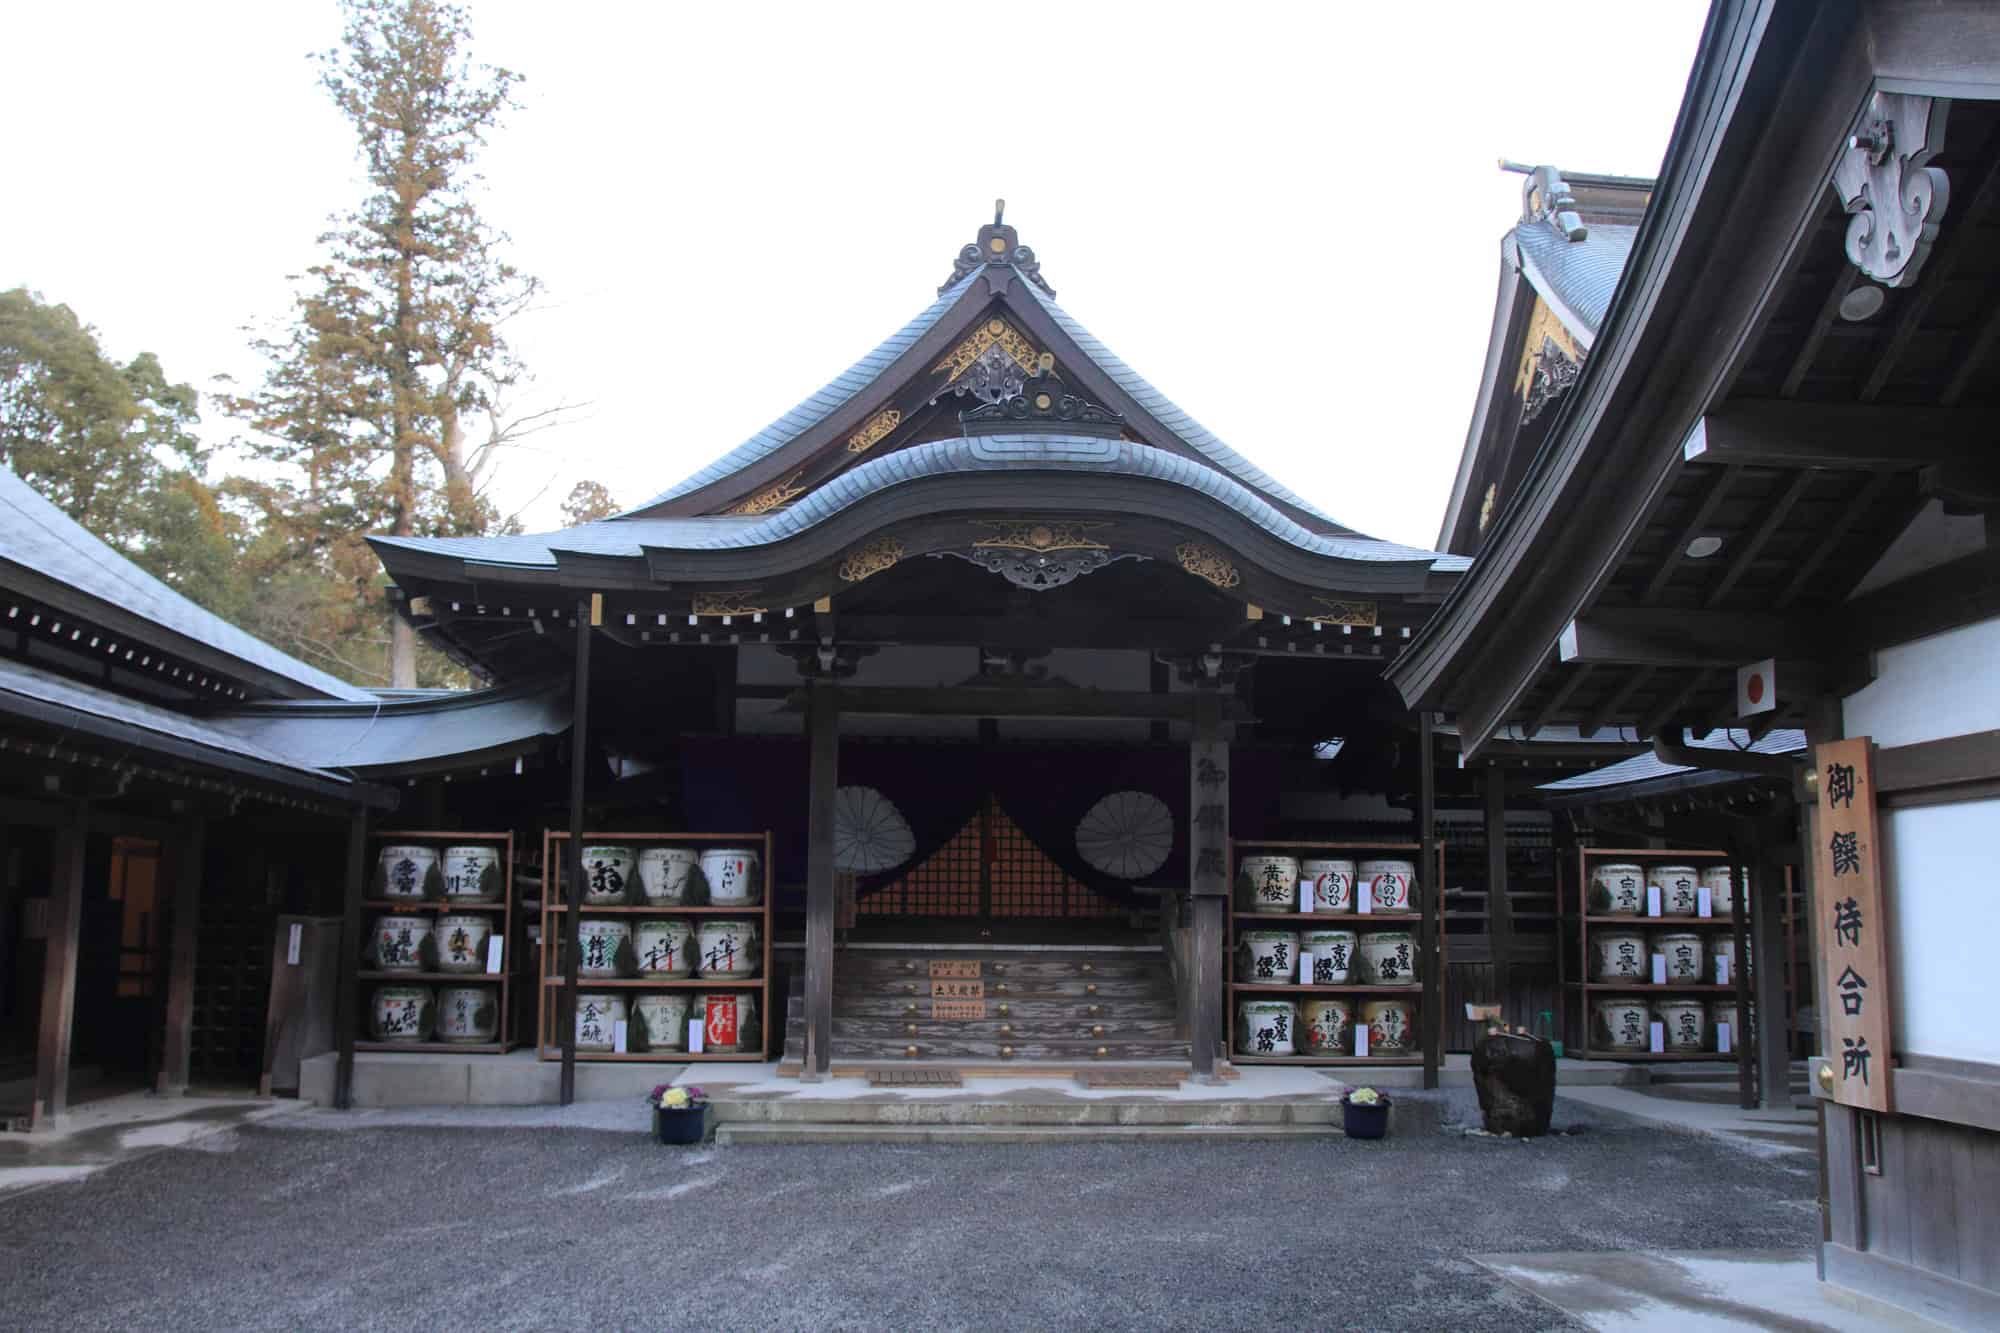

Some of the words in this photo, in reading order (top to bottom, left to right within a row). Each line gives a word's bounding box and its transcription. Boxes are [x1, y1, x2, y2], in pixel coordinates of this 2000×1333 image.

[1327, 872, 1341, 906] ねのひ
[1382, 872, 1397, 907] ねのひ
[1827, 763, 1872, 1086] 御饌待合所
